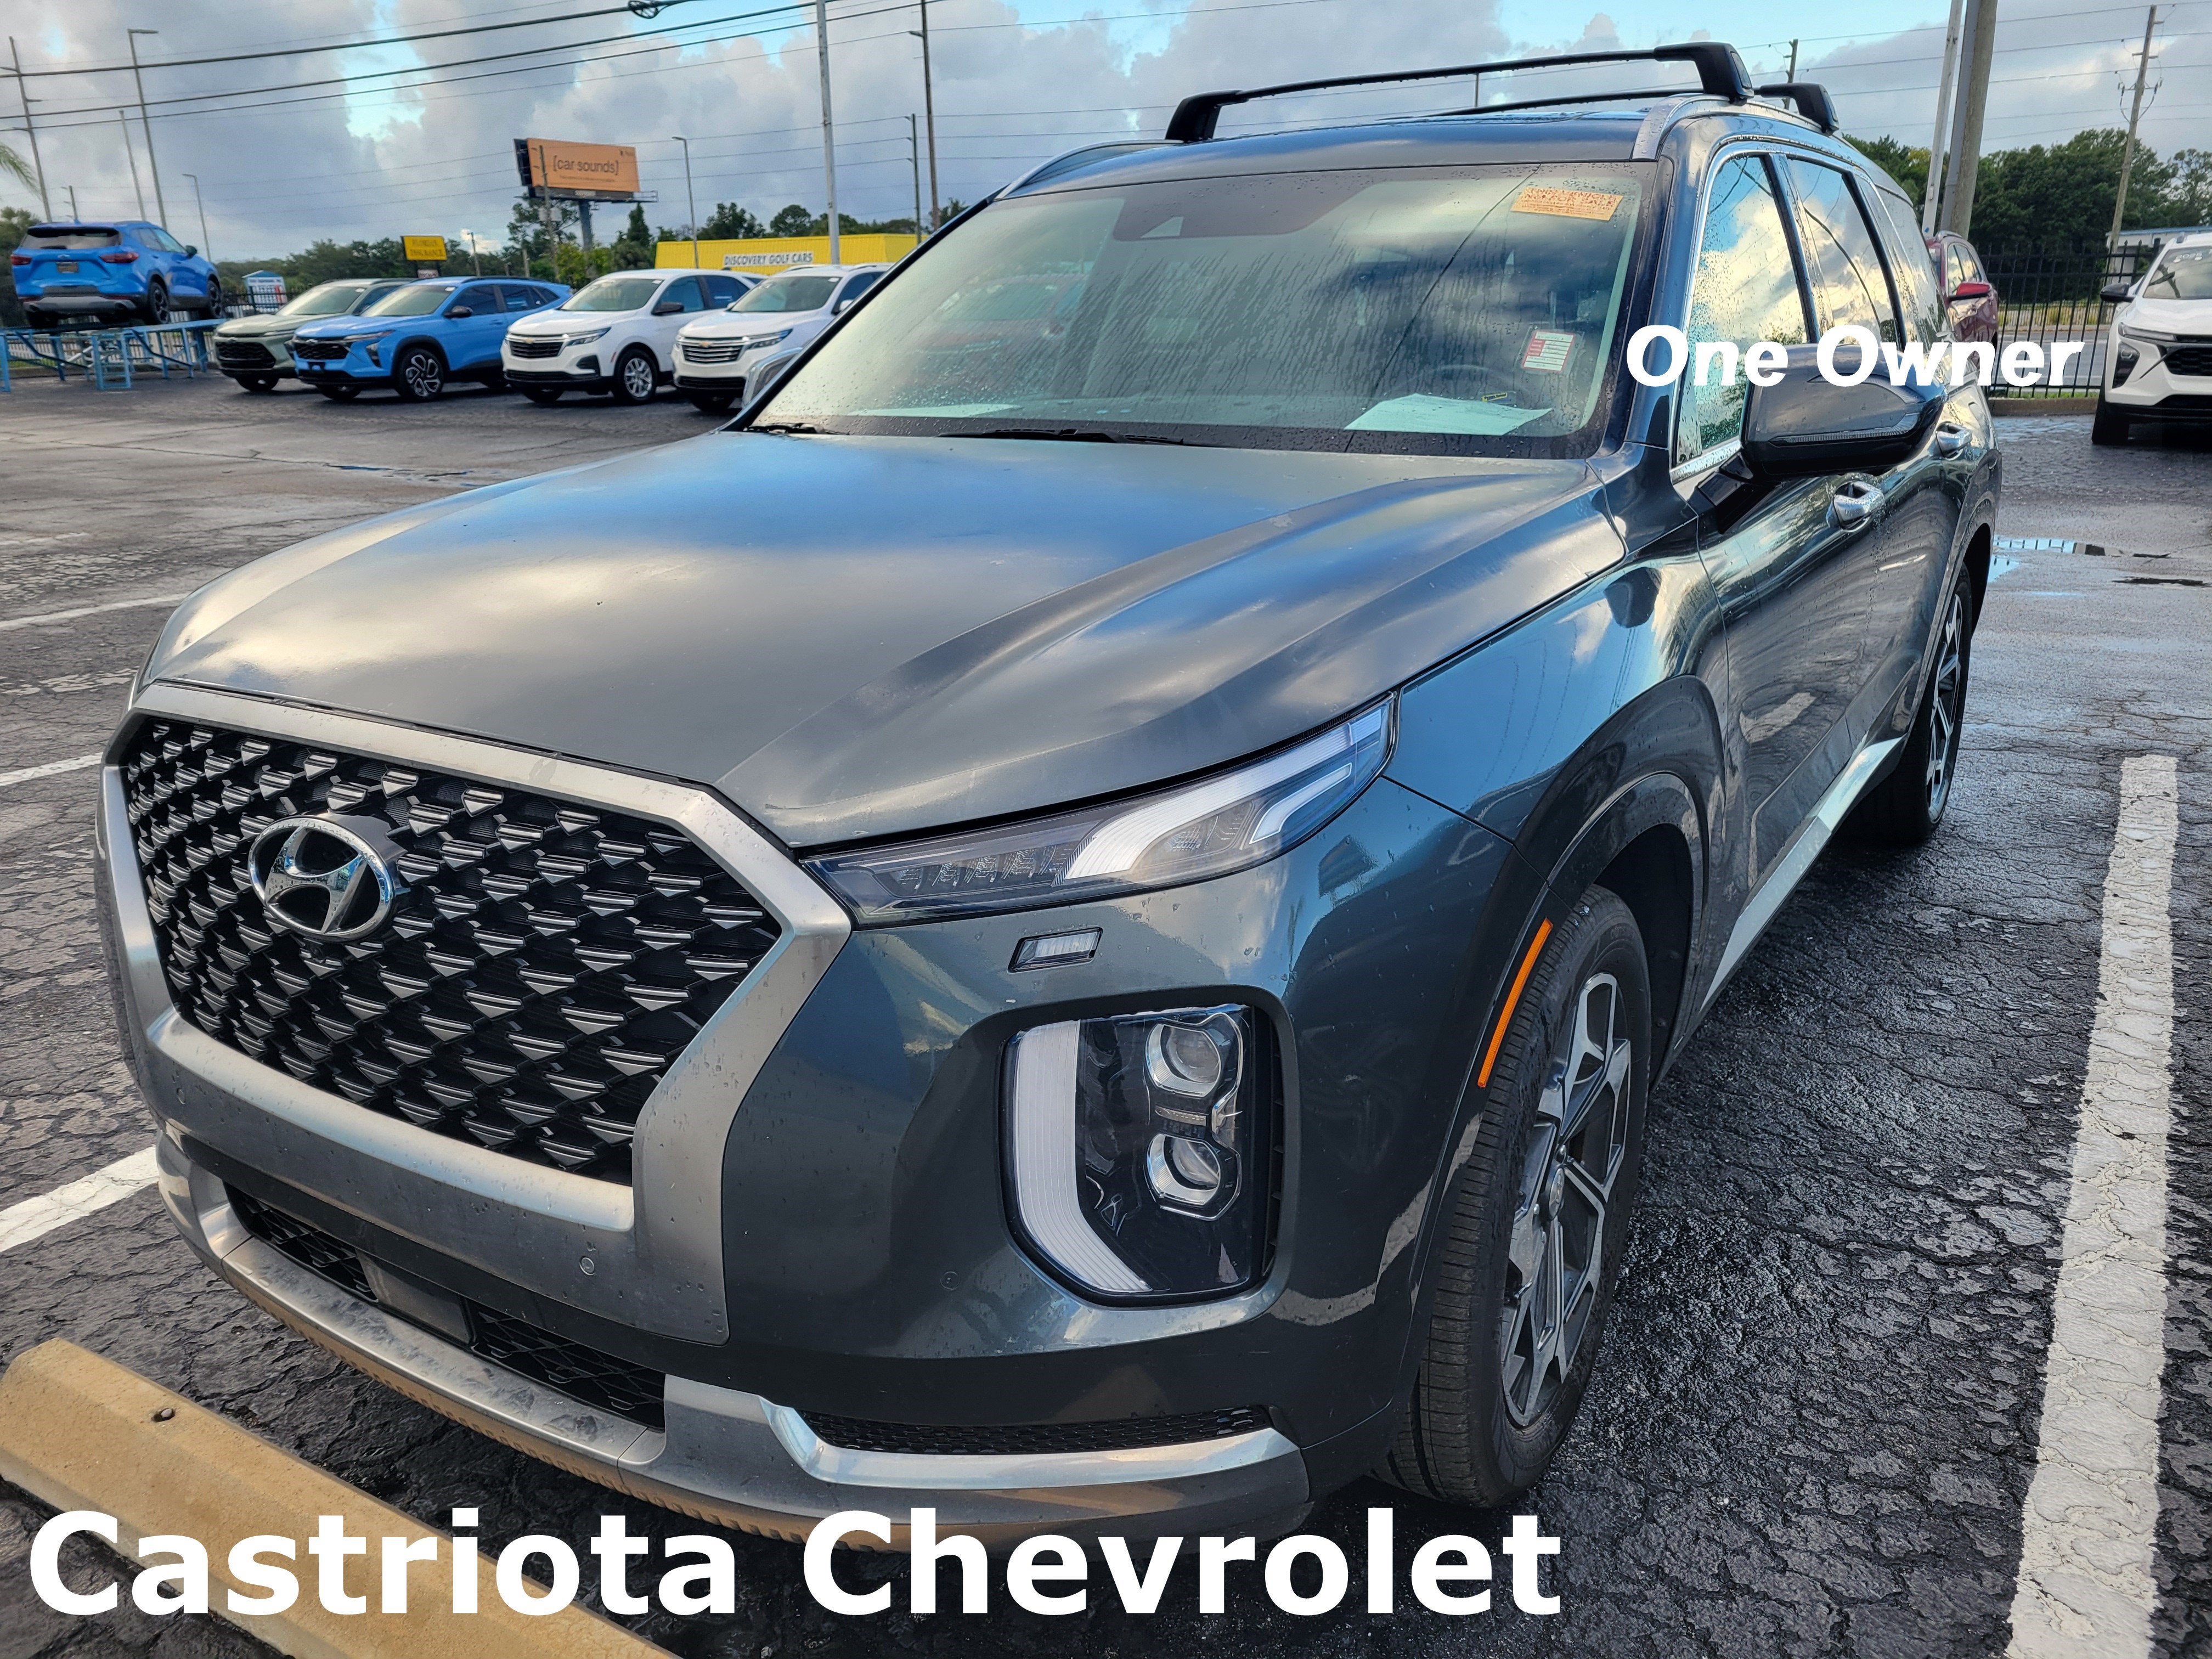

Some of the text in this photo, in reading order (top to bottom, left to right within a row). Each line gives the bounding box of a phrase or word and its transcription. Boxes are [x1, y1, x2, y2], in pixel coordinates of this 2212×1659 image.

[554, 155, 619, 176] [car sounds]
[725, 252, 812, 266] DISCOVERY GOLF CARS
